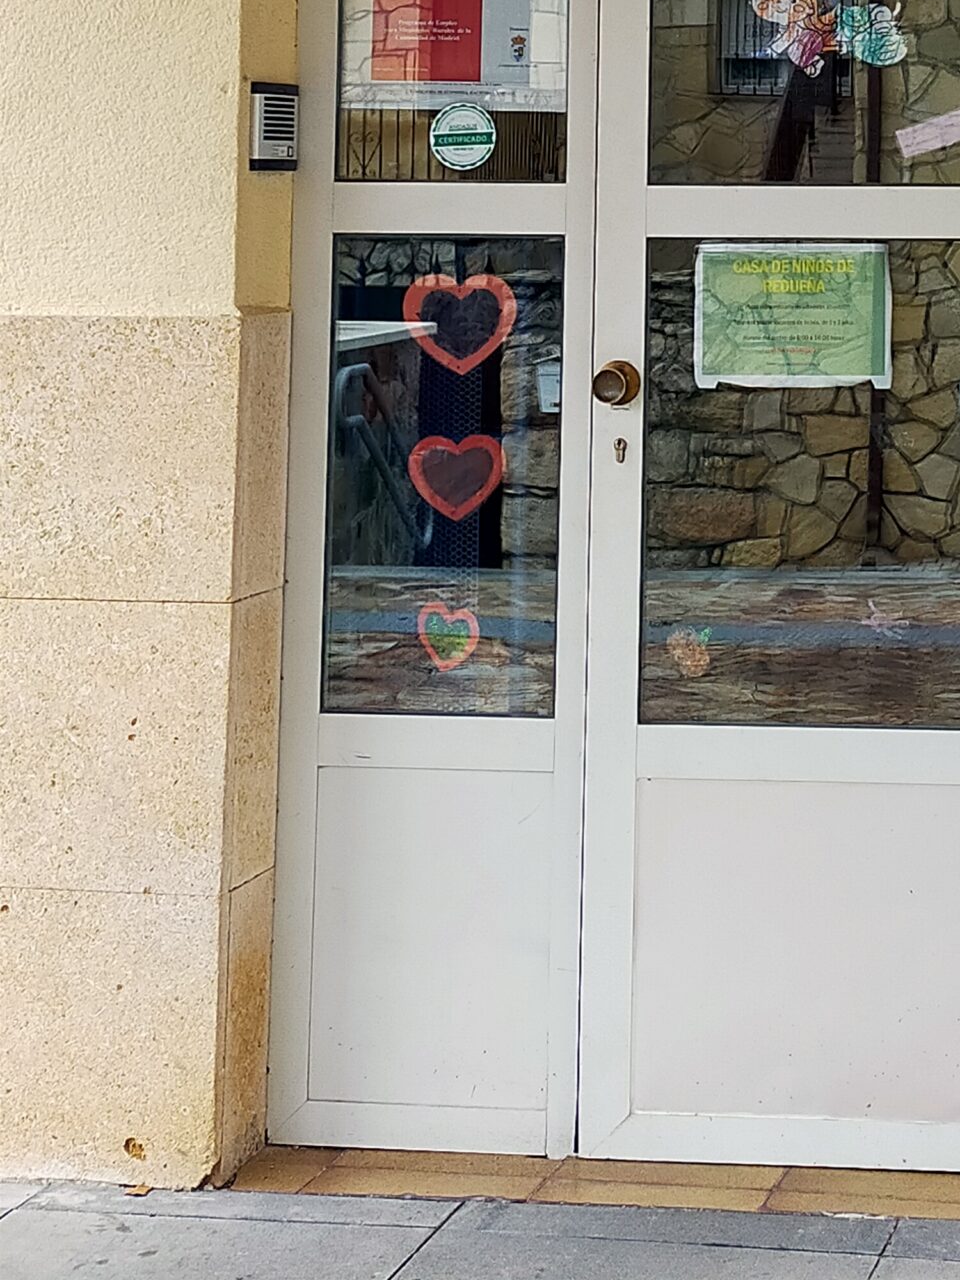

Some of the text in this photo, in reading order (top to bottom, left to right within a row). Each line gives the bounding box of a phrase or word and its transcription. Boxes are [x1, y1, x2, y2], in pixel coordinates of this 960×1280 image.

[439, 136, 487, 144] CERTIFICADO
[733, 254, 855, 274] CASA DE NIÑOS DE
